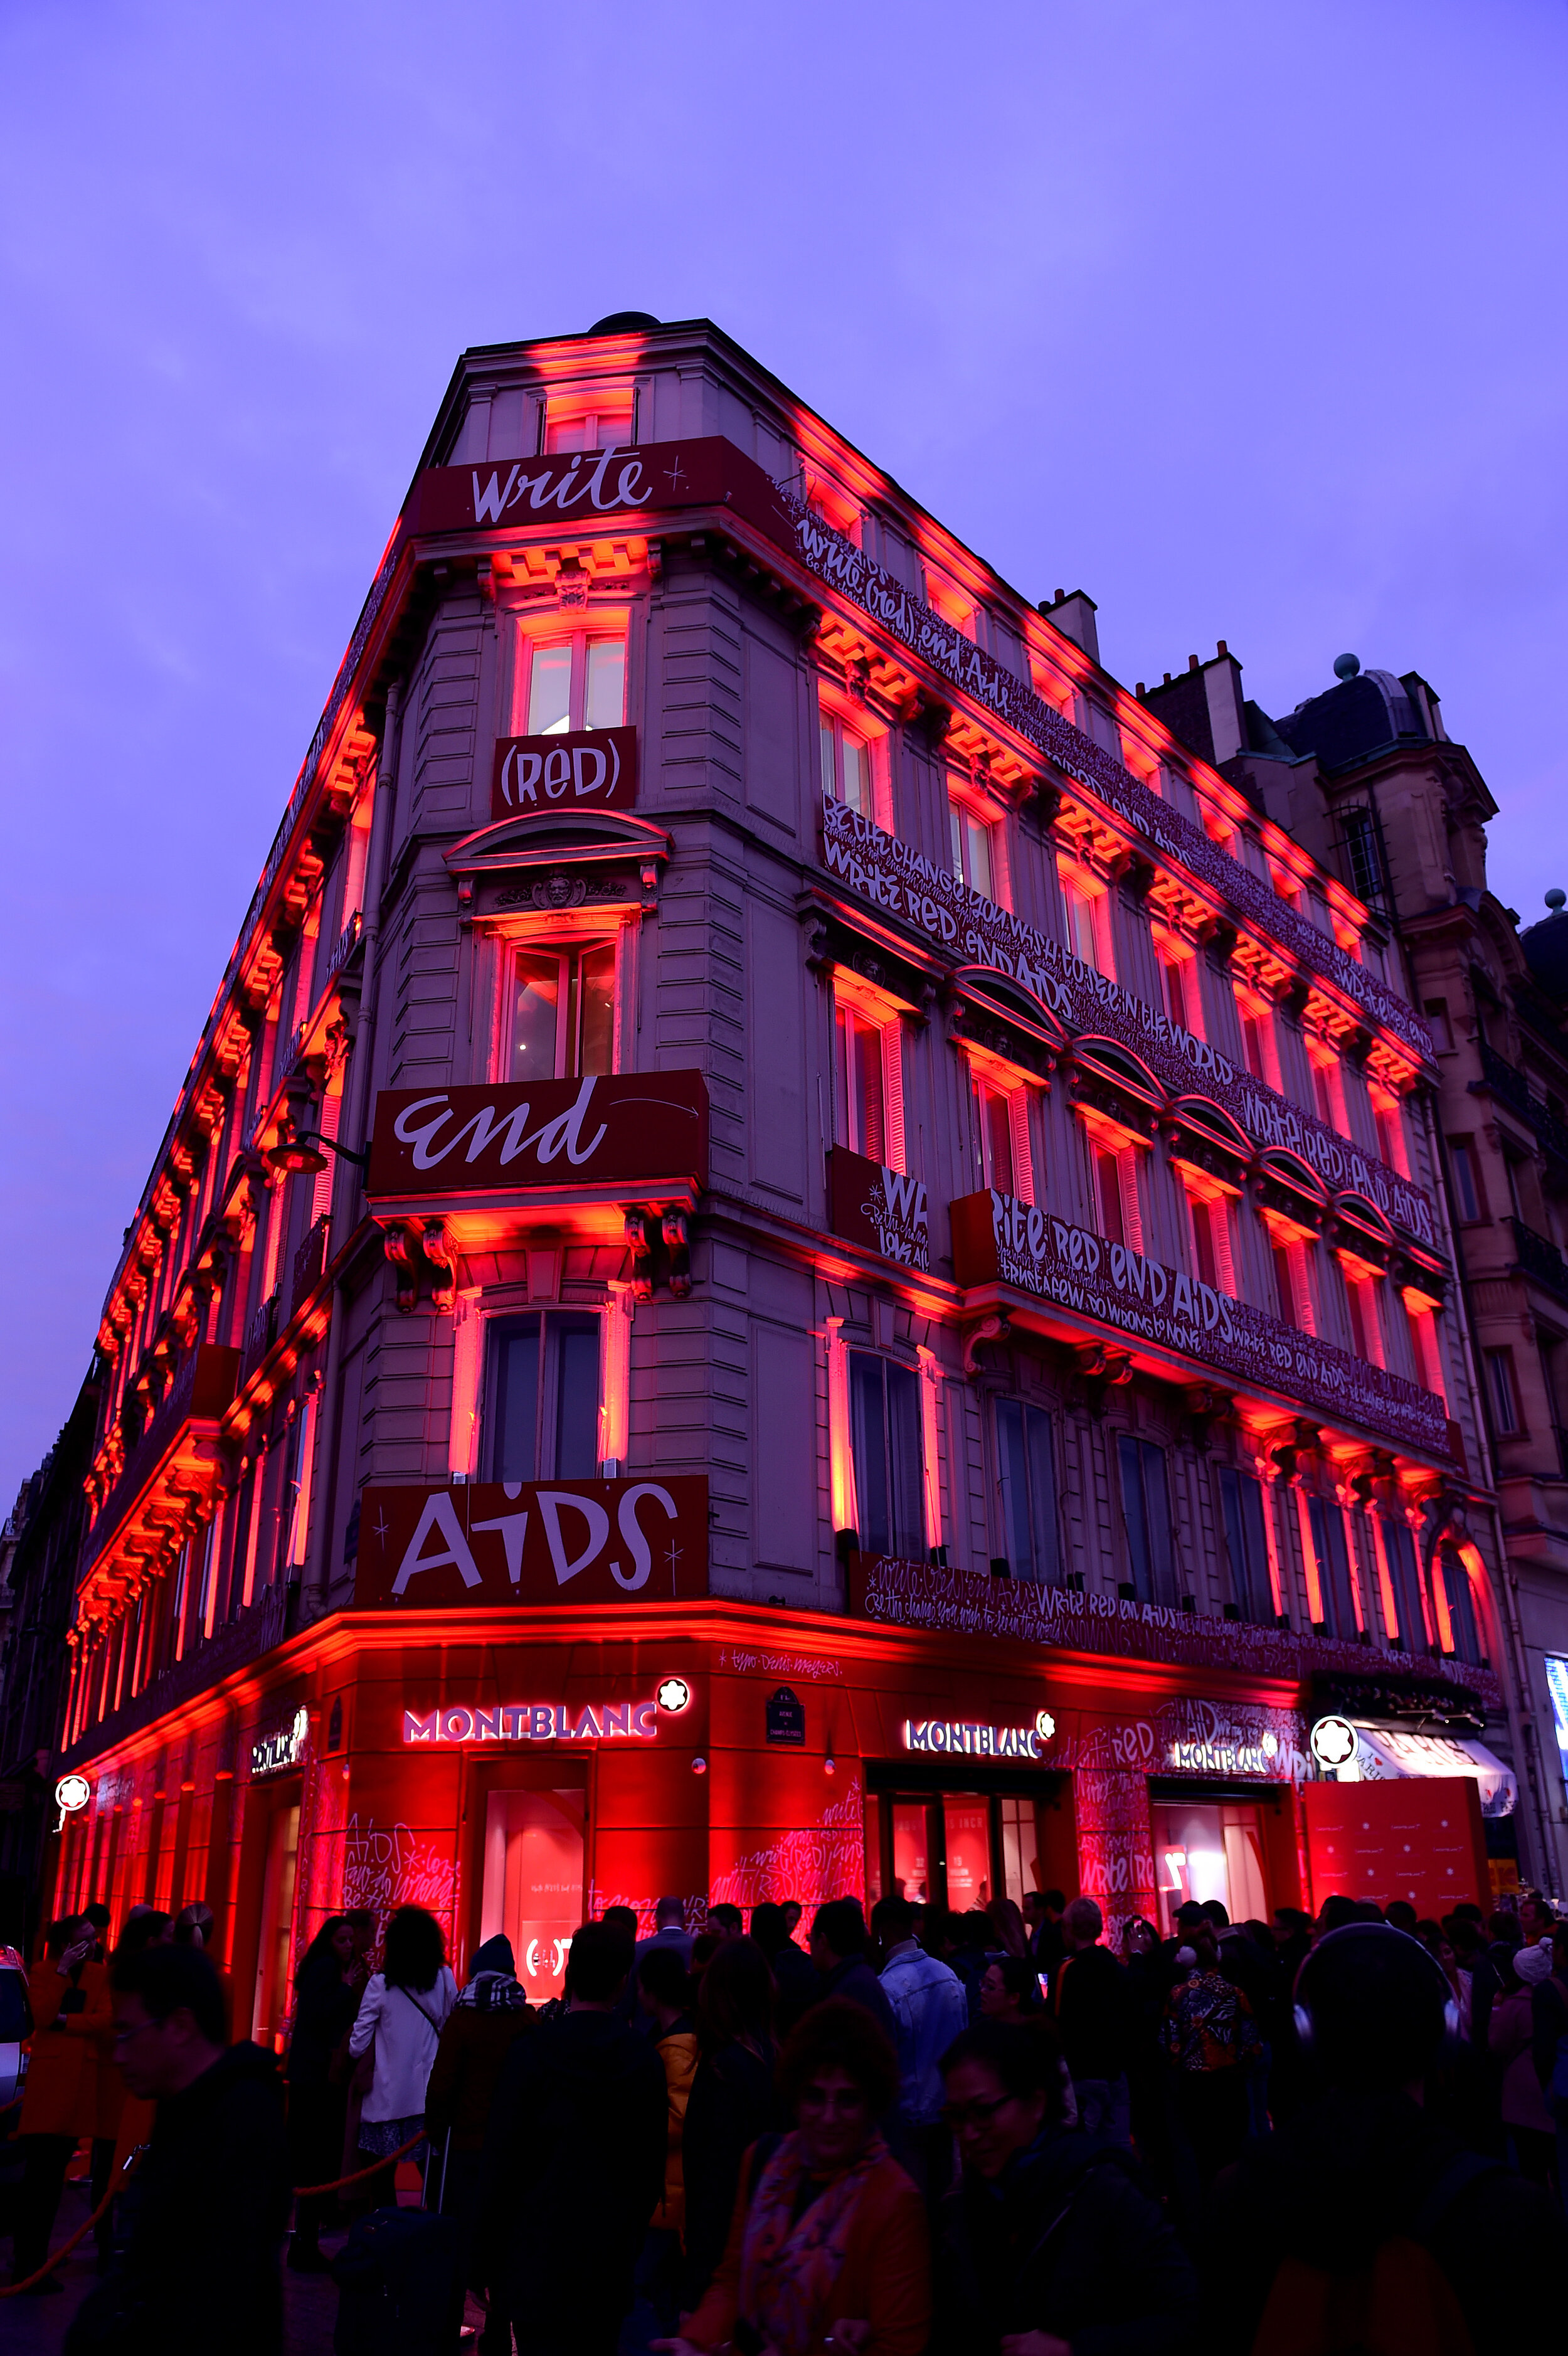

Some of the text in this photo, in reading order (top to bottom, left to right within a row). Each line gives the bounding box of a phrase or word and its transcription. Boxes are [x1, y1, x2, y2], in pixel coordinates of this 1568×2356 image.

[472, 448, 652, 523] Write
[404, 1703, 657, 1742] MONTBLANC
[906, 1719, 1042, 1758] MONTBLANC
